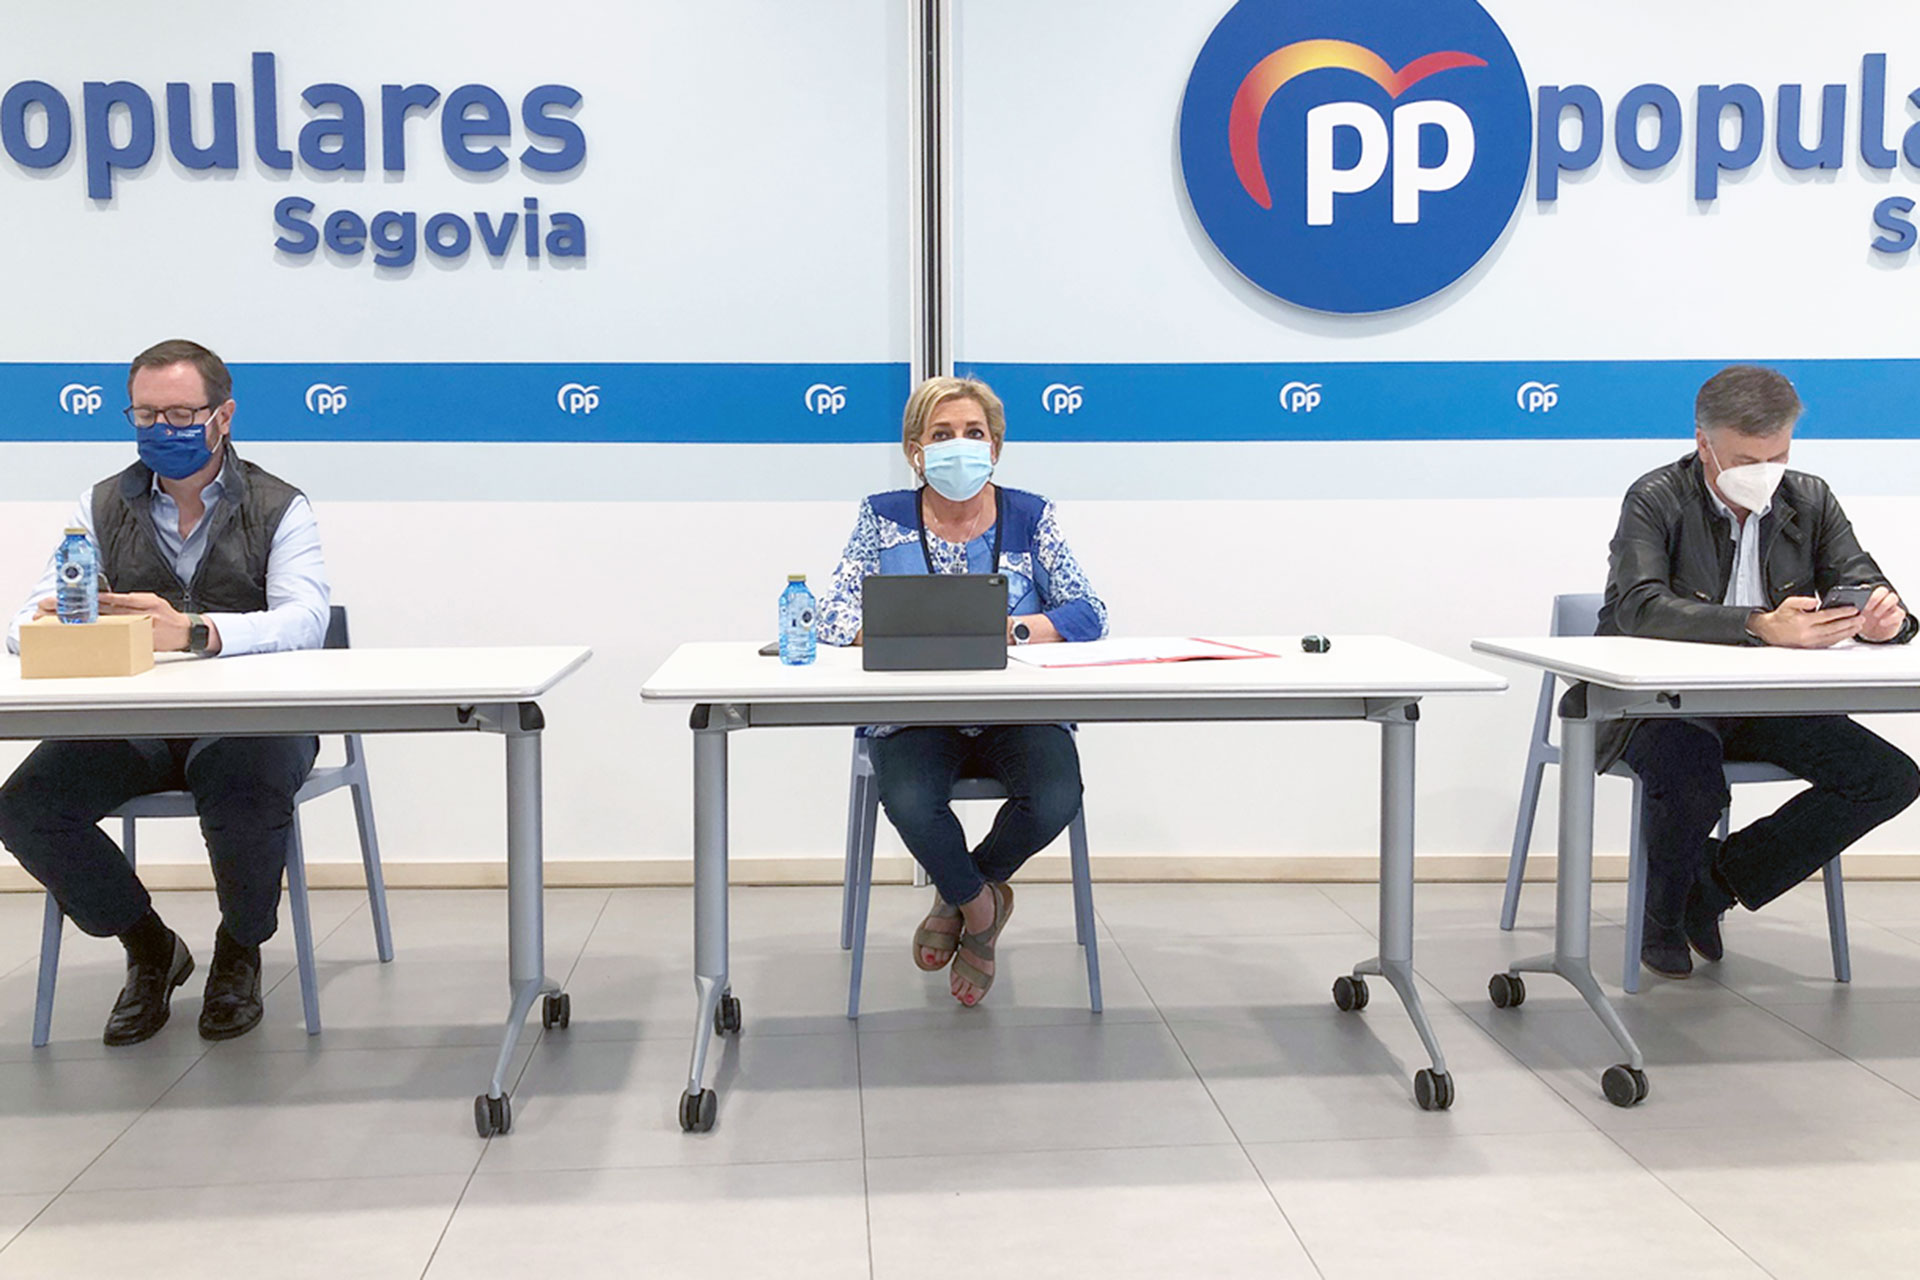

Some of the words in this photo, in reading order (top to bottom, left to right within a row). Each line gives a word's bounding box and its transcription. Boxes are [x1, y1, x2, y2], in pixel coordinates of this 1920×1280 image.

[1, 52, 586, 199] opulares
[1537, 53, 1920, 201] popul
[275, 197, 585, 267] Segovia
